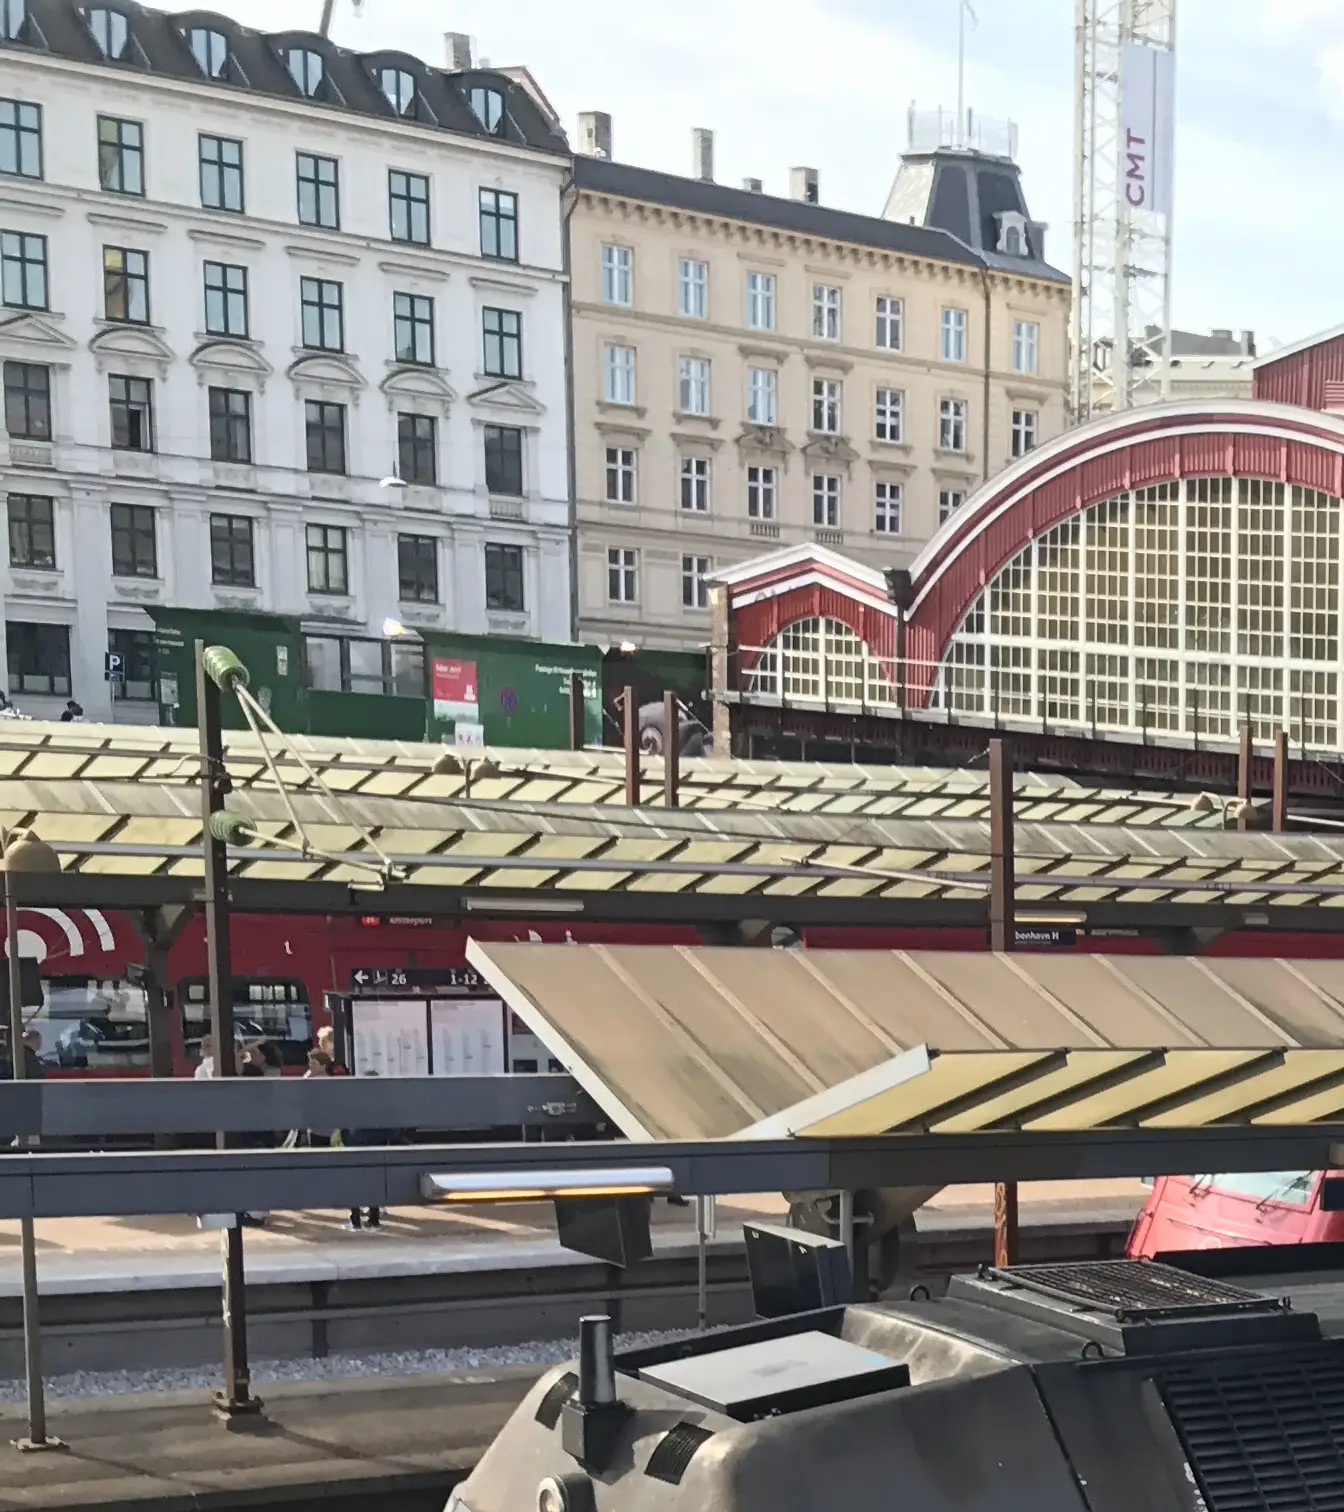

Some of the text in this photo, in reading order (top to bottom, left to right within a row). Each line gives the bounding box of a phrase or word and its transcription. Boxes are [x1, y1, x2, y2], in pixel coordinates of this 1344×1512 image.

[1125, 127, 1146, 208] CMT
[109, 654, 121, 666] P
[1015, 931, 1060, 941] benhavn H
[391, 973, 407, 985] 26
